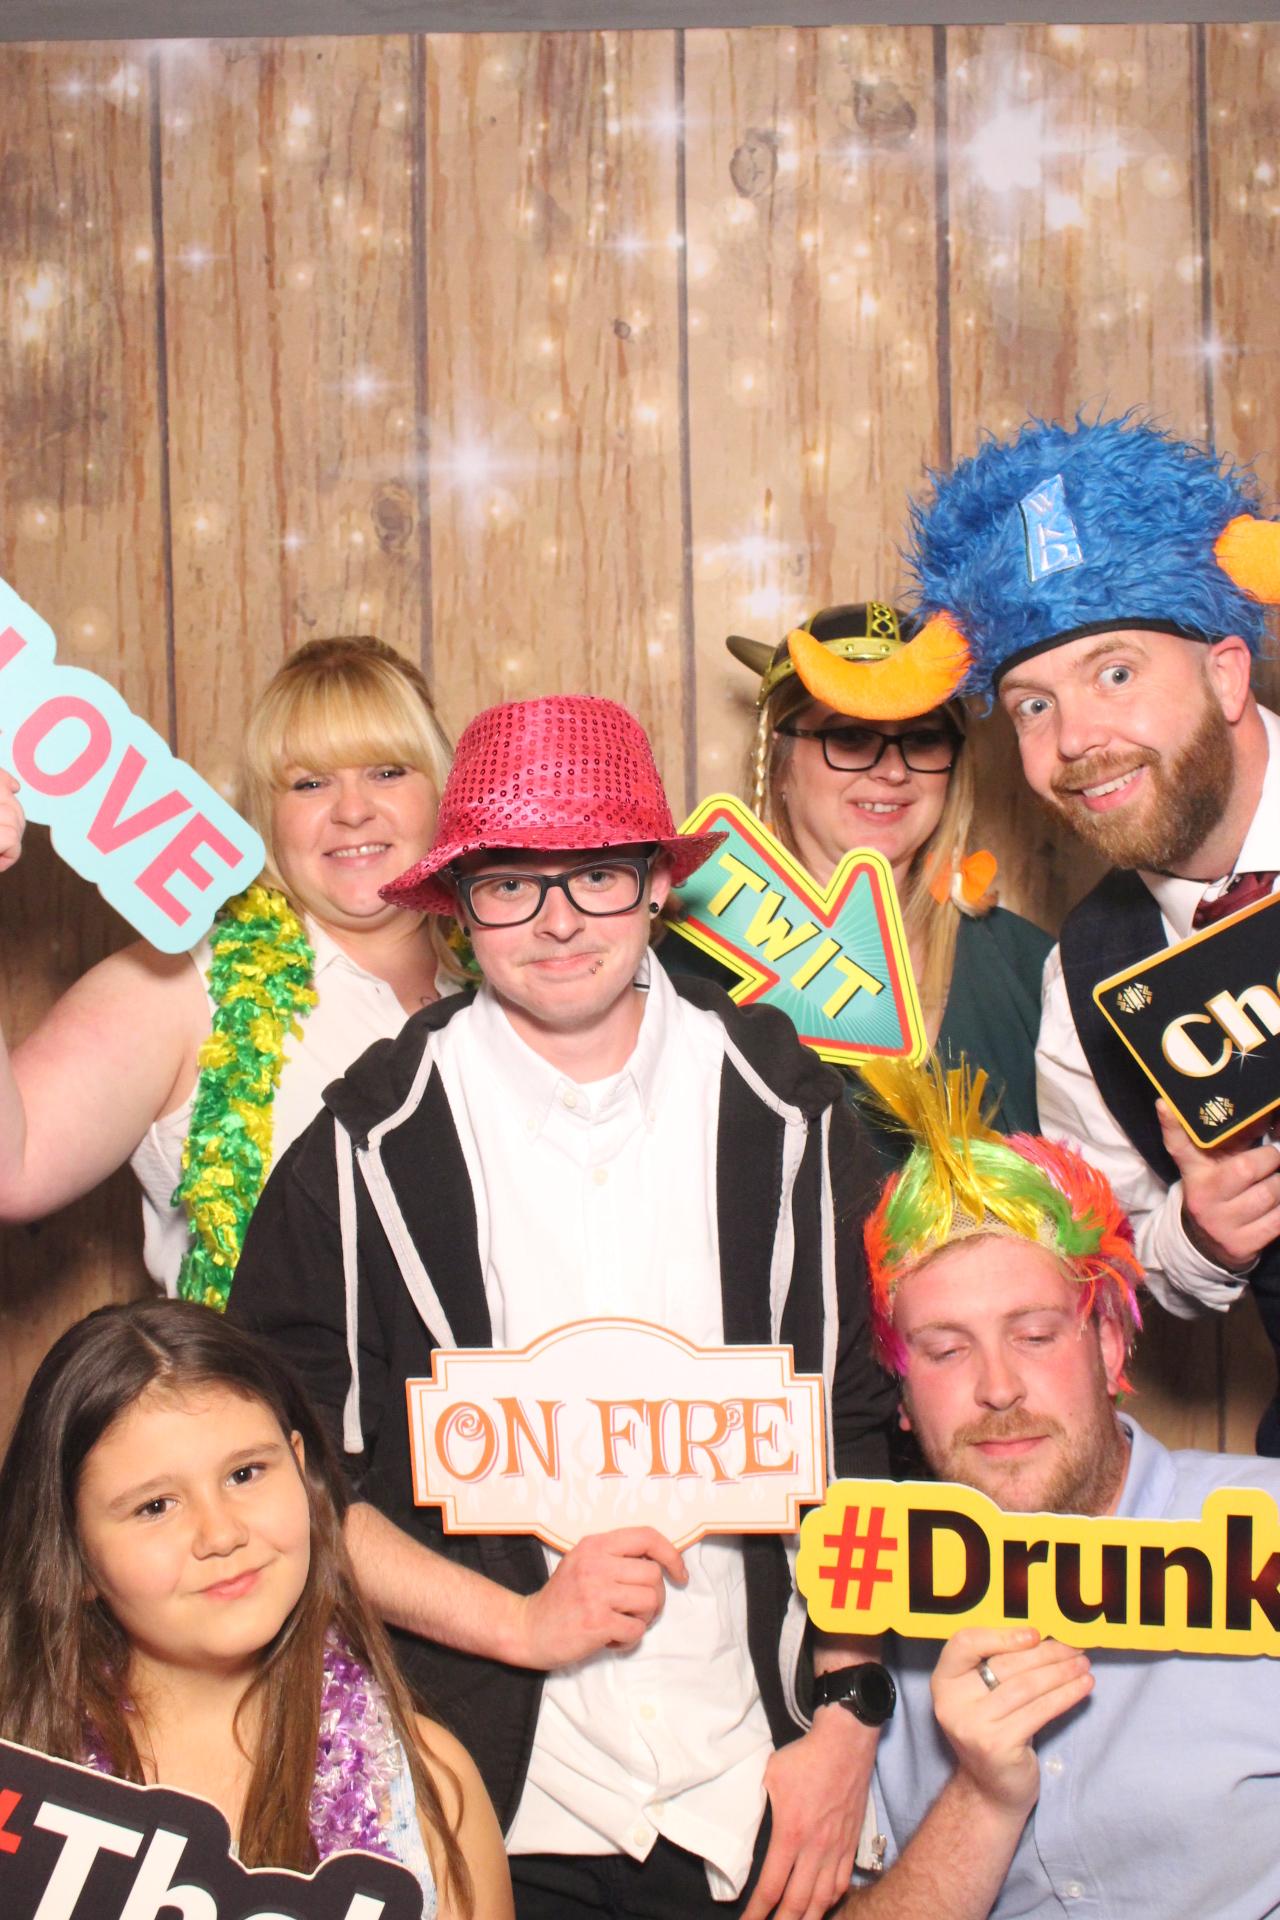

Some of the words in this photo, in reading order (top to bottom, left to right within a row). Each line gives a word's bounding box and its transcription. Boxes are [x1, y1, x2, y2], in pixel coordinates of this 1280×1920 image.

[0, 626, 244, 927] OVE
[707, 853, 886, 1020] TWIT
[1162, 970, 1280, 1078] Ch
[434, 1397, 567, 1484] ON
[586, 1396, 800, 1486] FIRE
